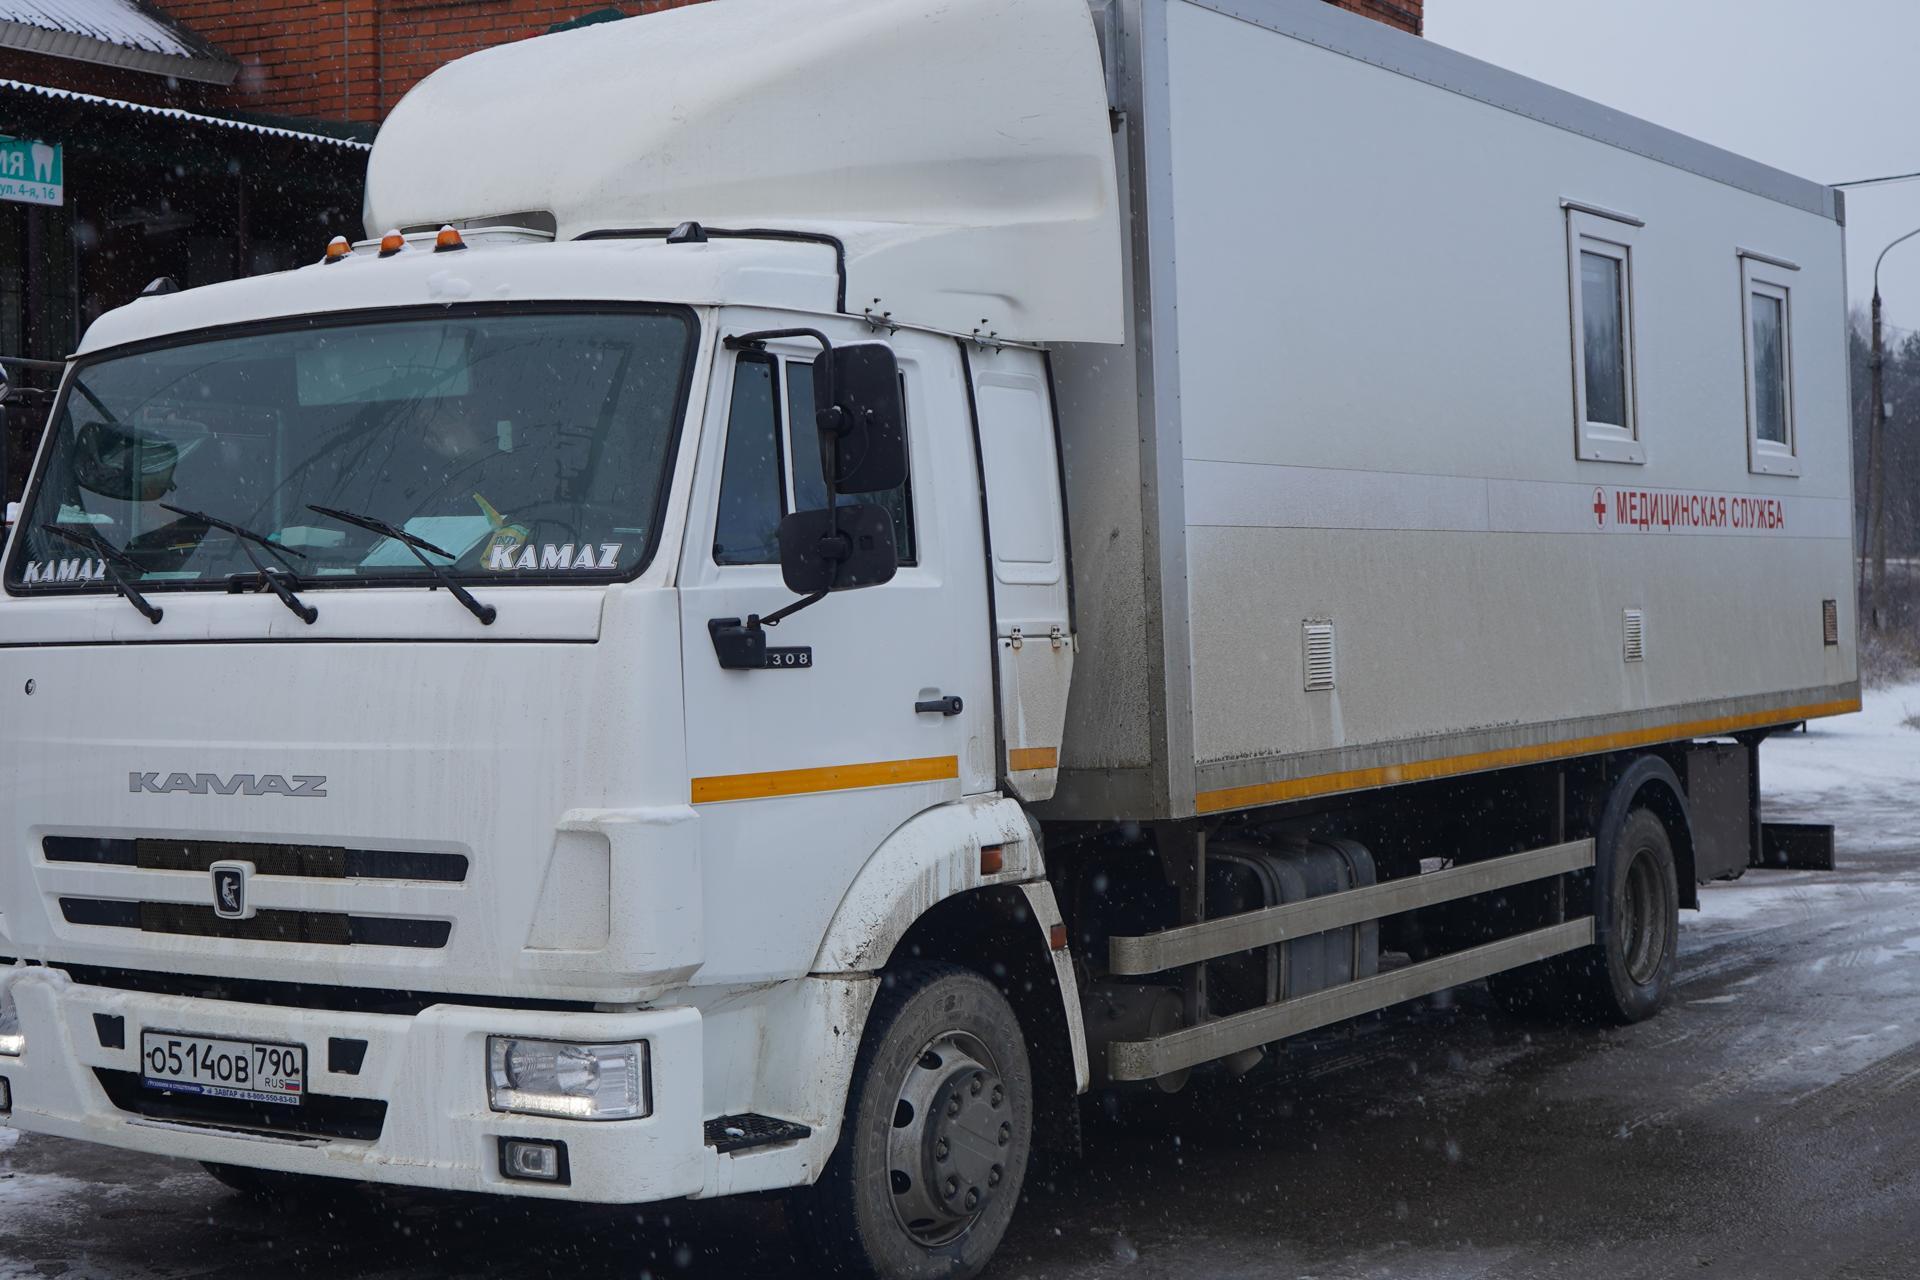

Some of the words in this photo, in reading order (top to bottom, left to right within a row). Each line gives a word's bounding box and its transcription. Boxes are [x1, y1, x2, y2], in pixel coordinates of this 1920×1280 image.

[42, 187, 56, 200] 16
[1616, 491, 1727, 531] МЕДИЦИНСКАЯ
[1731, 498, 1784, 529] СЛУЖБА
[489, 543, 623, 570] KAMAZ
[765, 653, 808, 665] 308
[129, 772, 327, 797] KAMAZ
[255, 1047, 295, 1077] 790
[214, 1088, 238, 1097] ЗАВГАР
[264, 1077, 284, 1089] RUS
